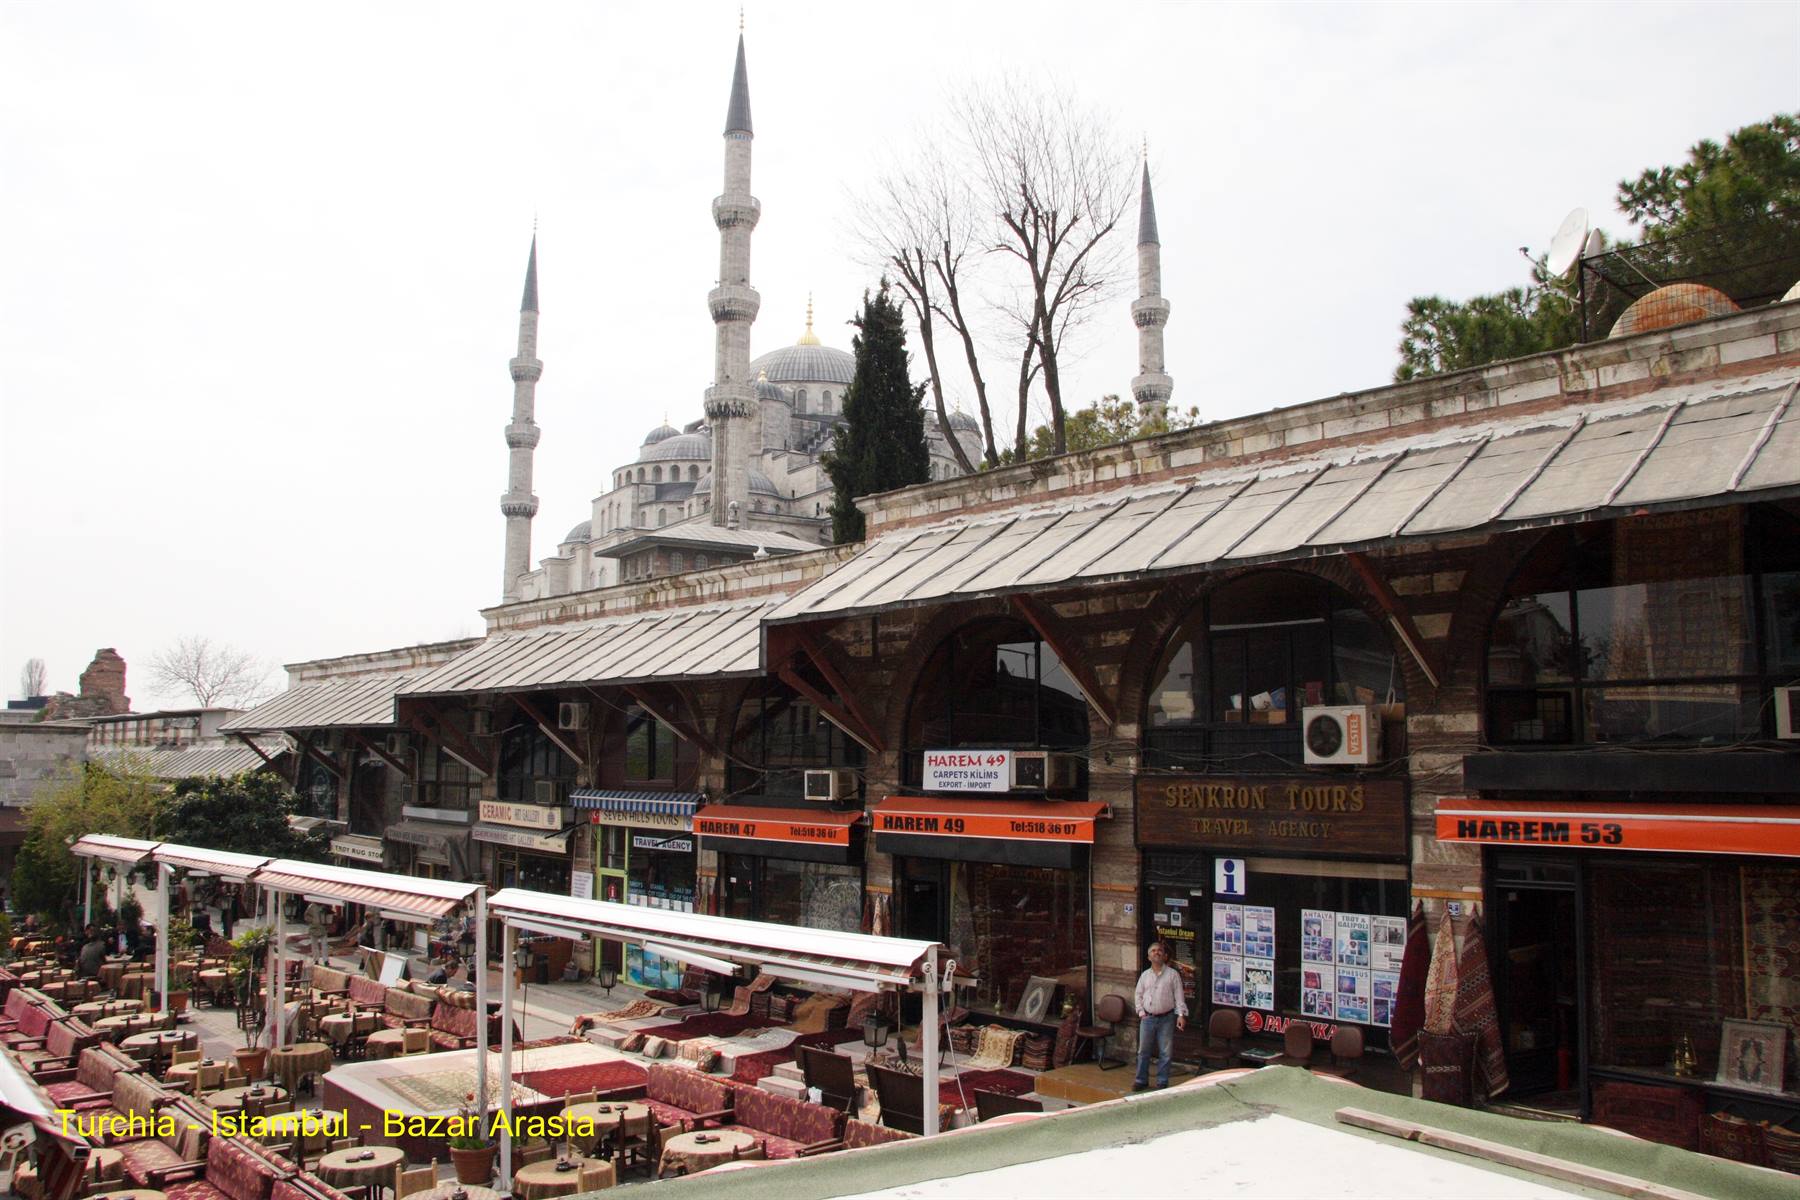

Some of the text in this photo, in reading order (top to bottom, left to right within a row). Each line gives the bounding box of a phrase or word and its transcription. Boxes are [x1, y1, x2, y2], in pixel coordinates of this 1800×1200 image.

[928, 755, 982, 767] HAREM
[986, 754, 1005, 766] 49
[933, 770, 968, 779] CARPETS
[1166, 784, 1364, 811] SENKRON TOURS
[482, 804, 512, 821] CERAMIC
[603, 811, 679, 826] SEVEN HILLS TOURS
[701, 821, 756, 836] HAREM 47
[790, 826, 815, 837] Tel:518
[884, 816, 964, 833] HAREM 49
[1010, 821, 1076, 835] Tel:518 36 07
[1191, 818, 1332, 838] TRAVEL AGENCY
[1457, 820, 1623, 844] HAREM 53
[351, 848, 366, 856] RUG
